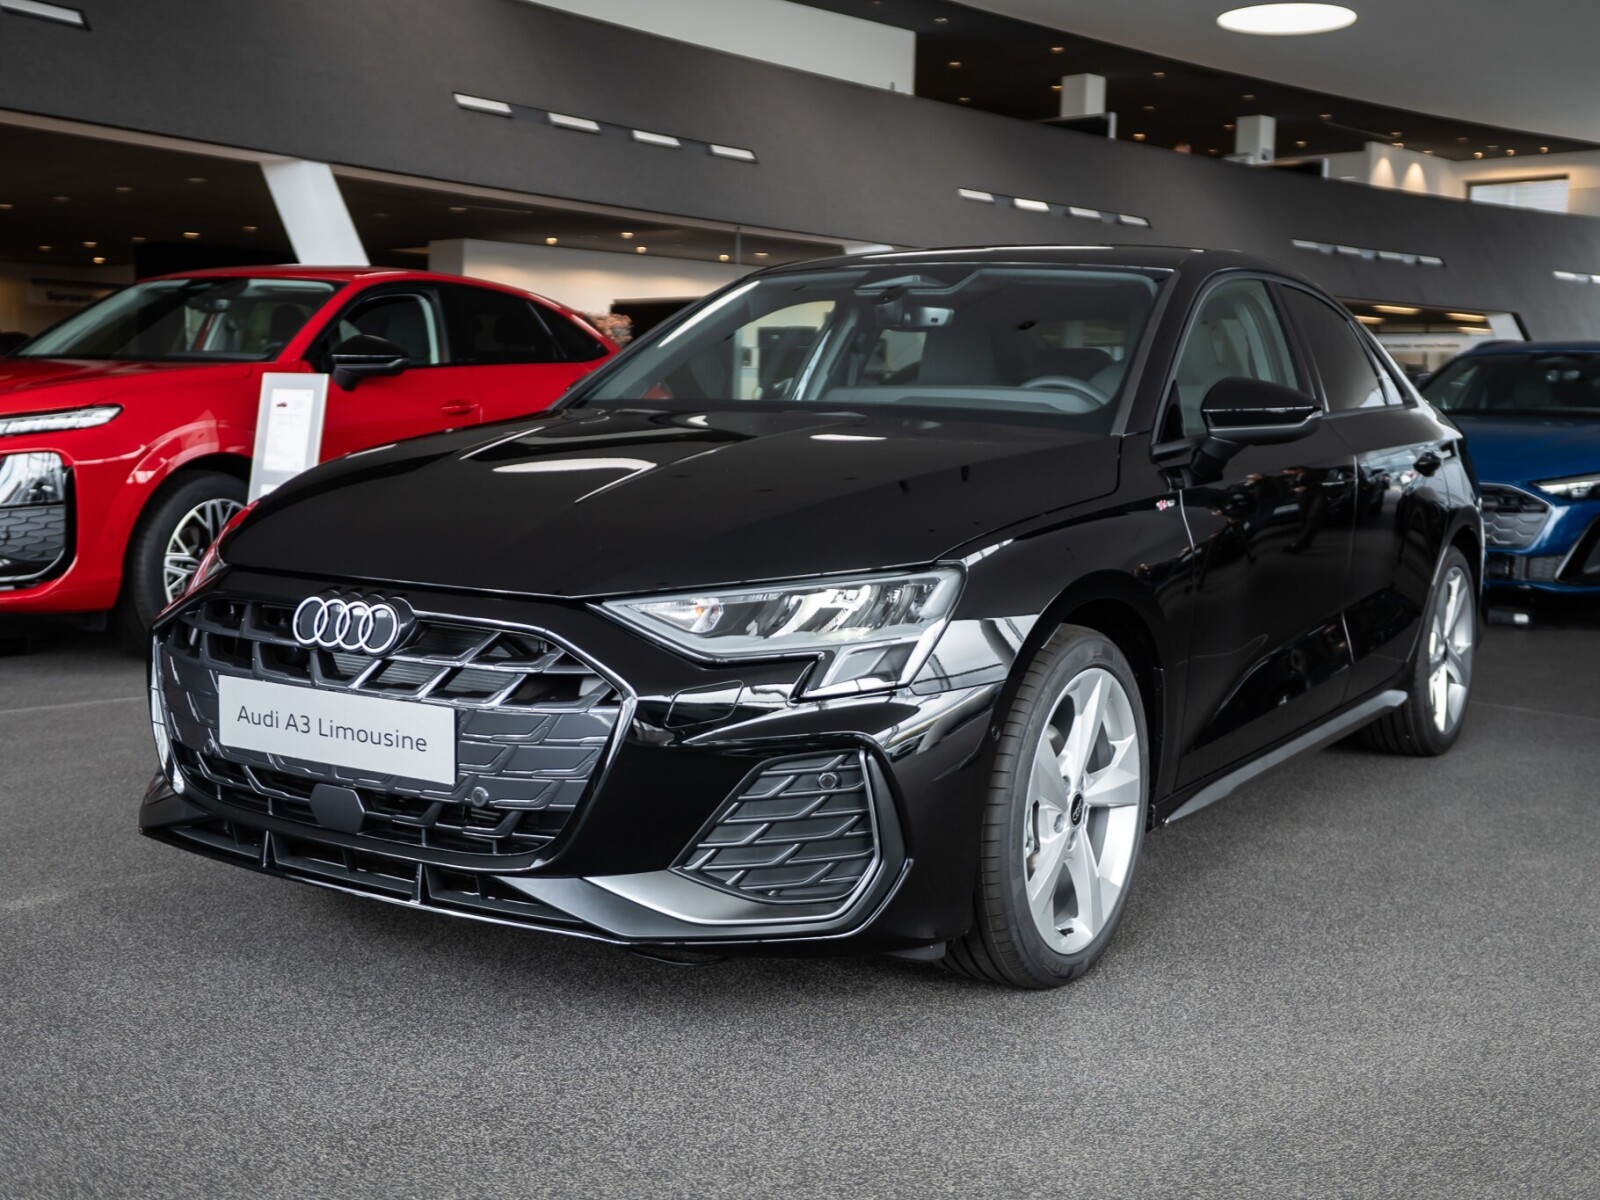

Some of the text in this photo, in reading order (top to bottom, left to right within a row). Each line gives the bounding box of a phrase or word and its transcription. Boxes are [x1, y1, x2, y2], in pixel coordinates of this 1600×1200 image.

[236, 705, 428, 753] Audi A3 Limousine
